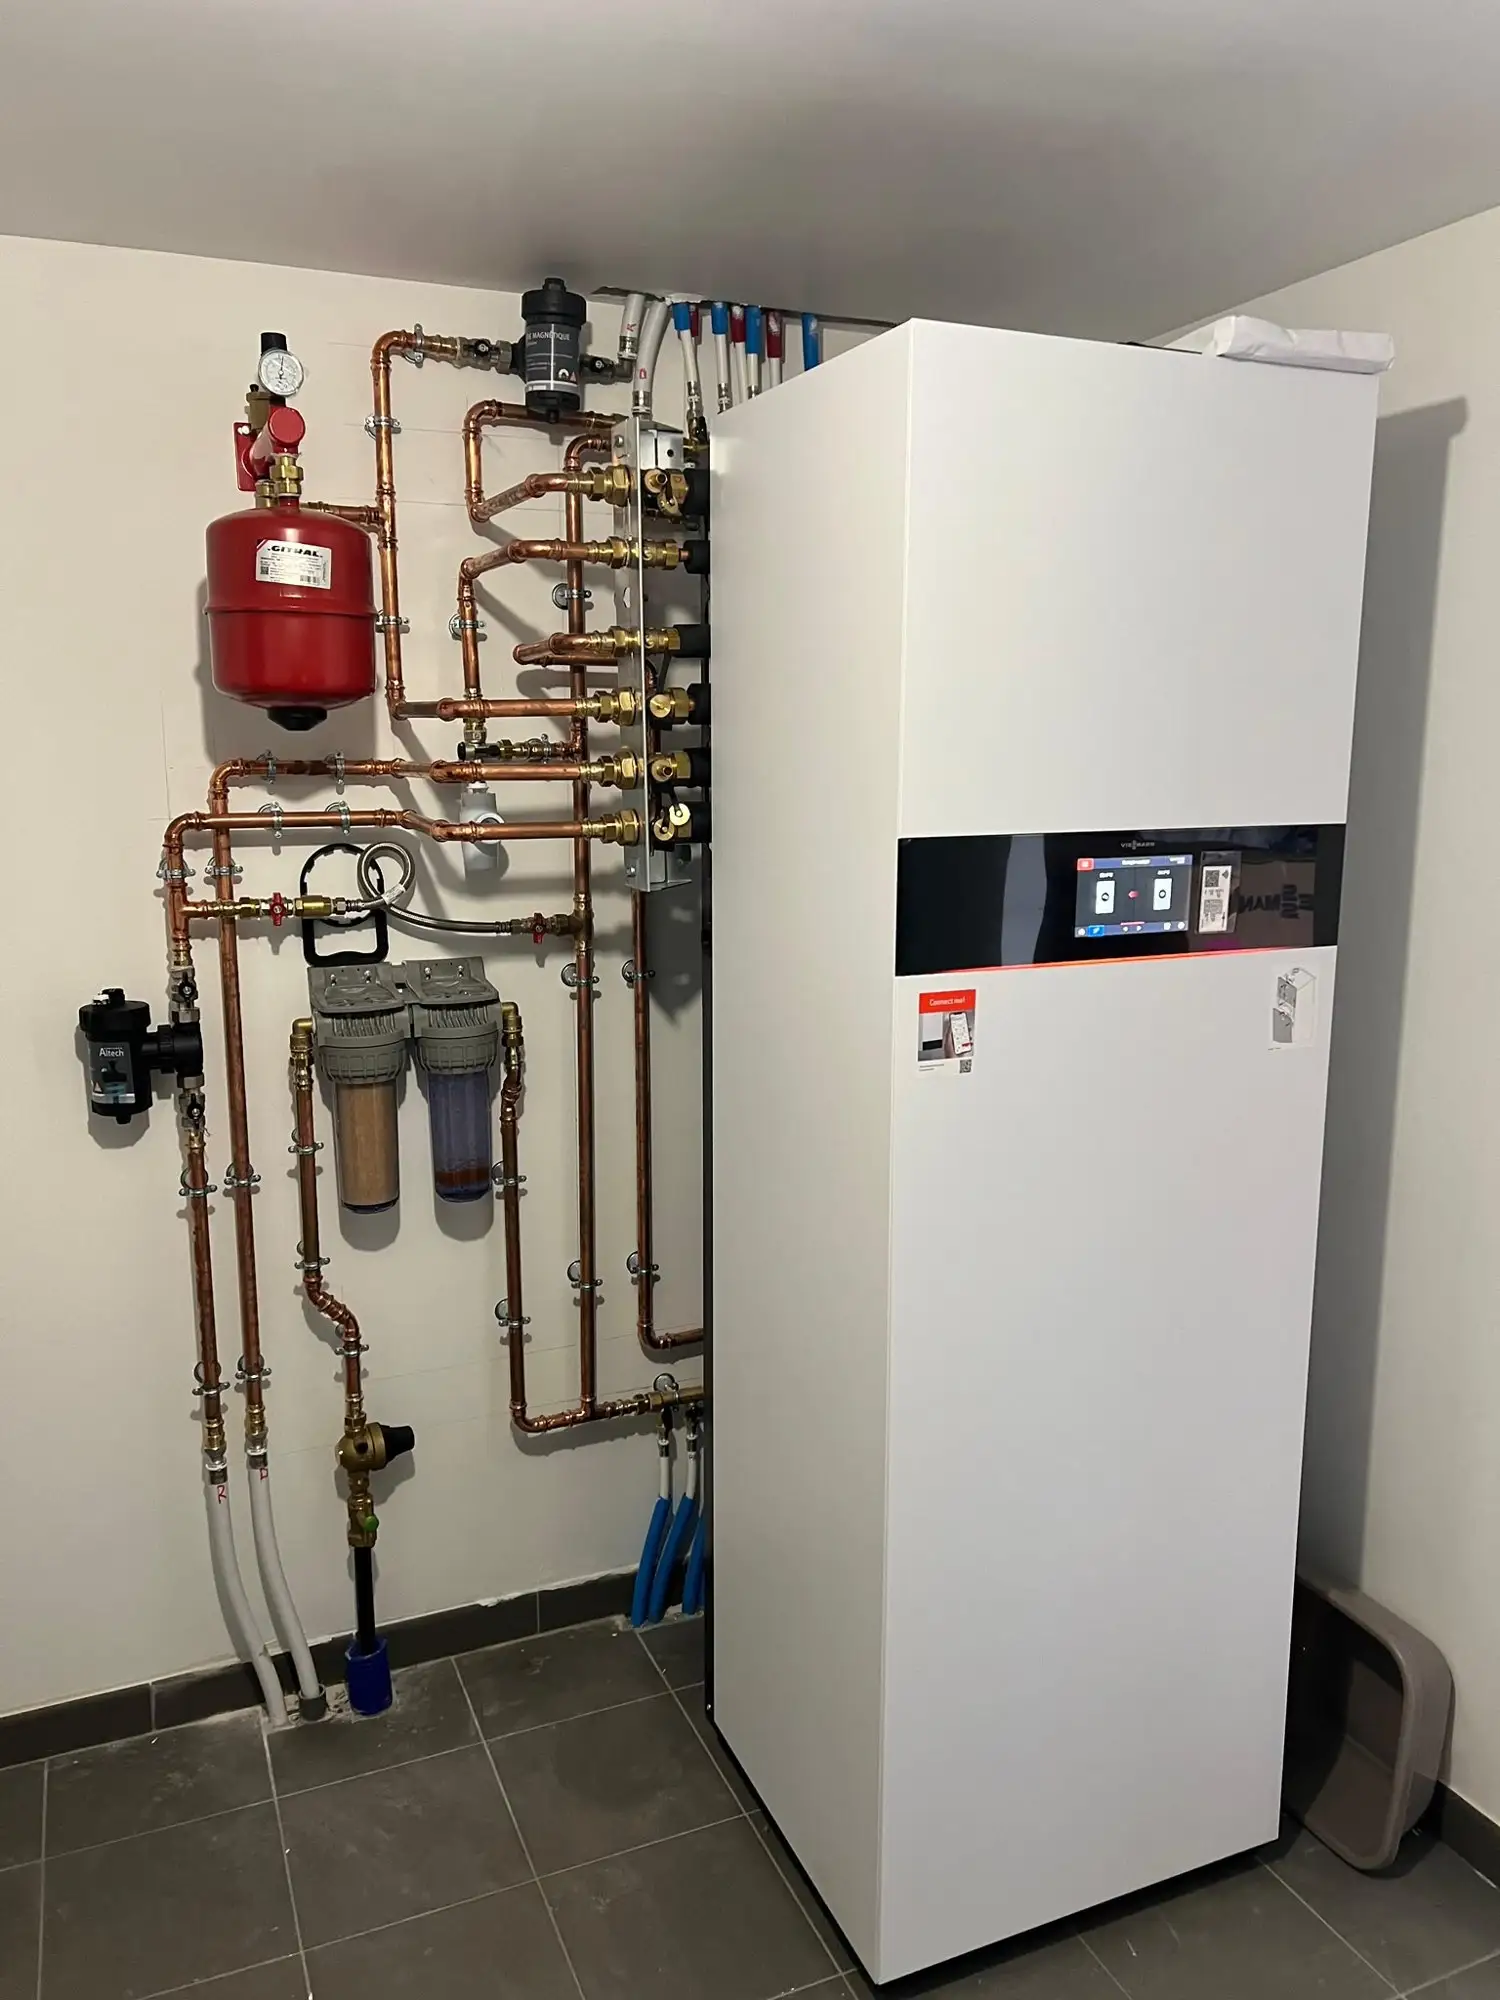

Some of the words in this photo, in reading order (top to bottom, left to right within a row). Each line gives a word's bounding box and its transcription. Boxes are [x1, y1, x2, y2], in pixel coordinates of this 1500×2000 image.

[929, 998, 954, 1007] Connect
[99, 1047, 124, 1057] Altech
[217, 1485, 226, 1504] R
